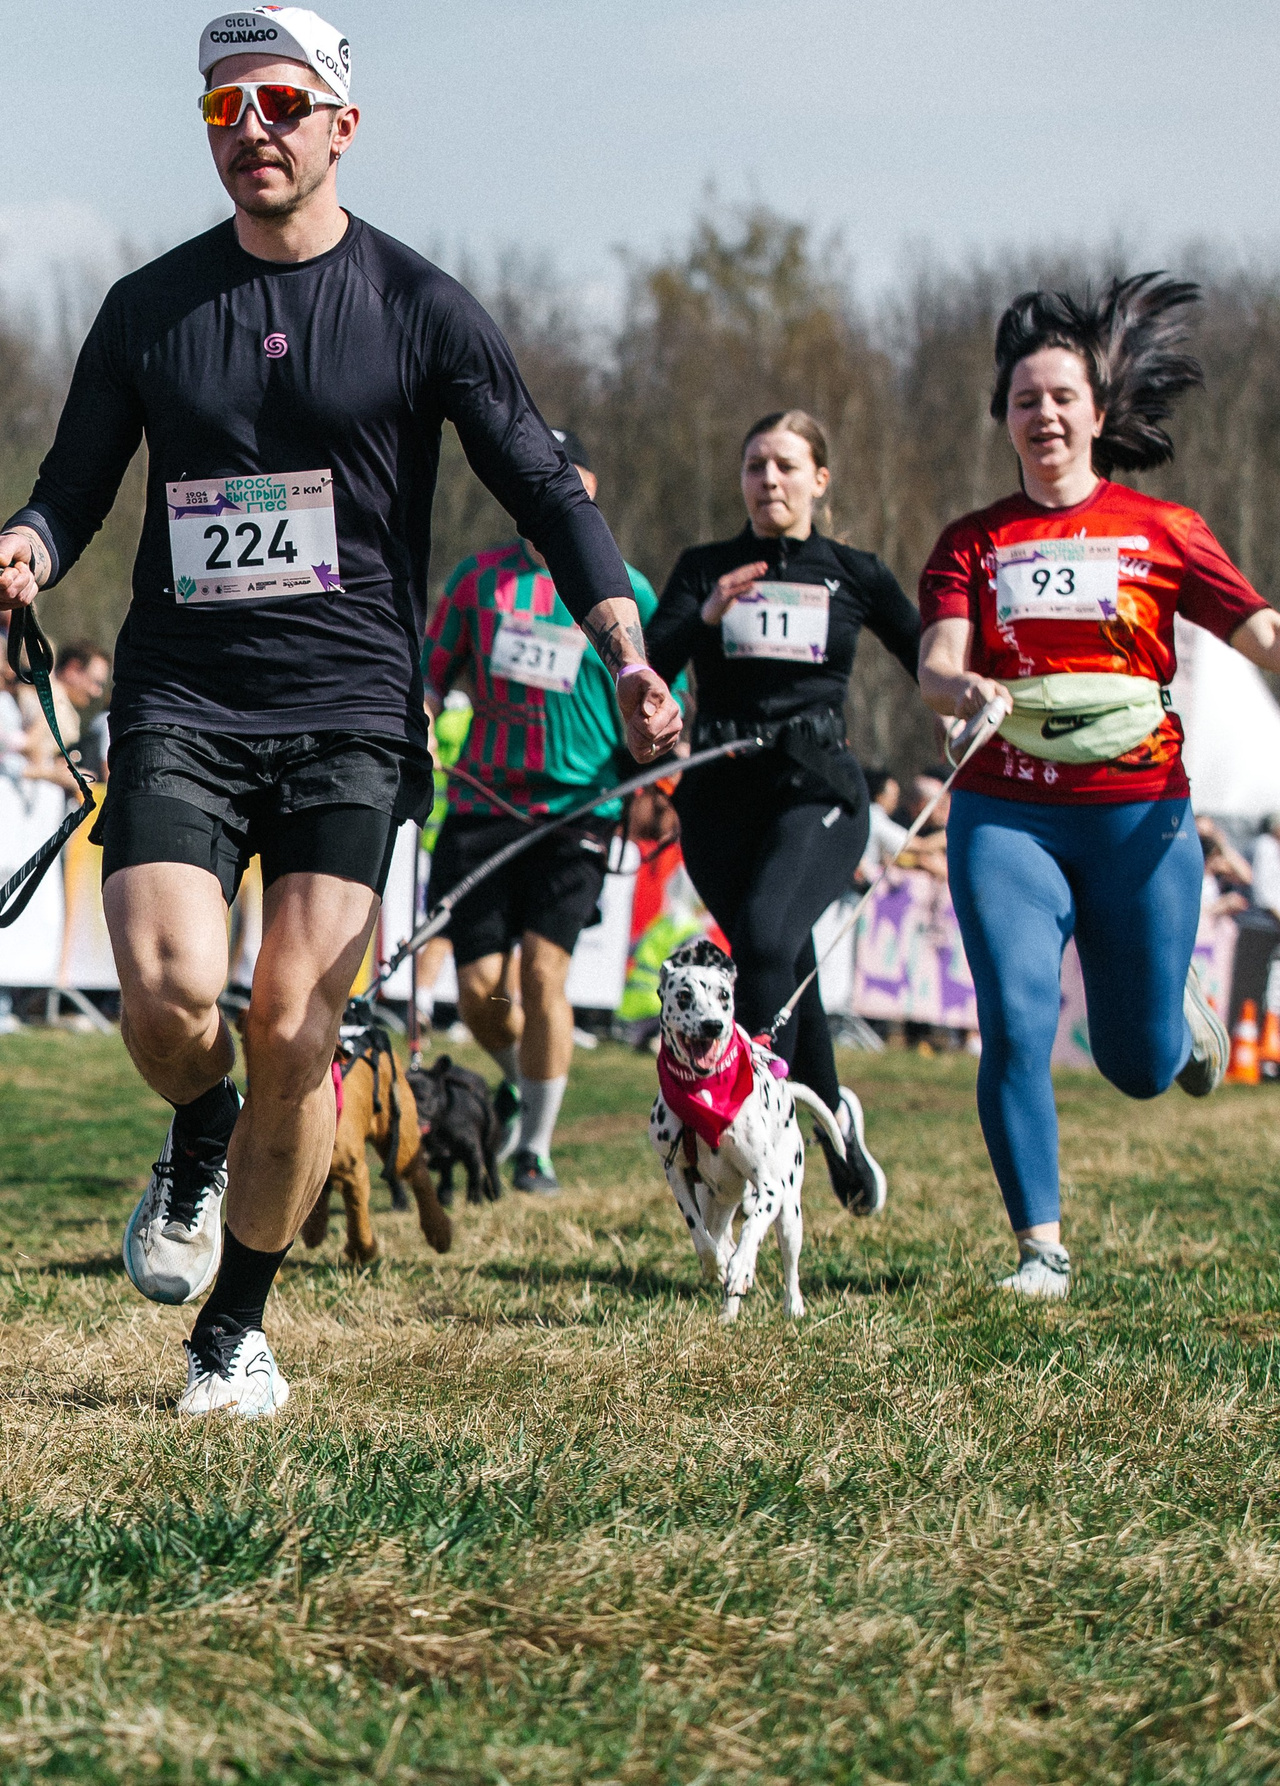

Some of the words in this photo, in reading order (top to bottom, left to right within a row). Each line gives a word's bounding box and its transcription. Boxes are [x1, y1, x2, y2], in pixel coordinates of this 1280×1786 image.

[210, 29, 278, 43] COLNAGO
[225, 18, 256, 28] CICLI
[291, 486, 300, 495] 2
[203, 519, 298, 570] 224
[1031, 568, 1075, 596] 93
[756, 610, 790, 637] 11
[509, 640, 558, 670] 231
